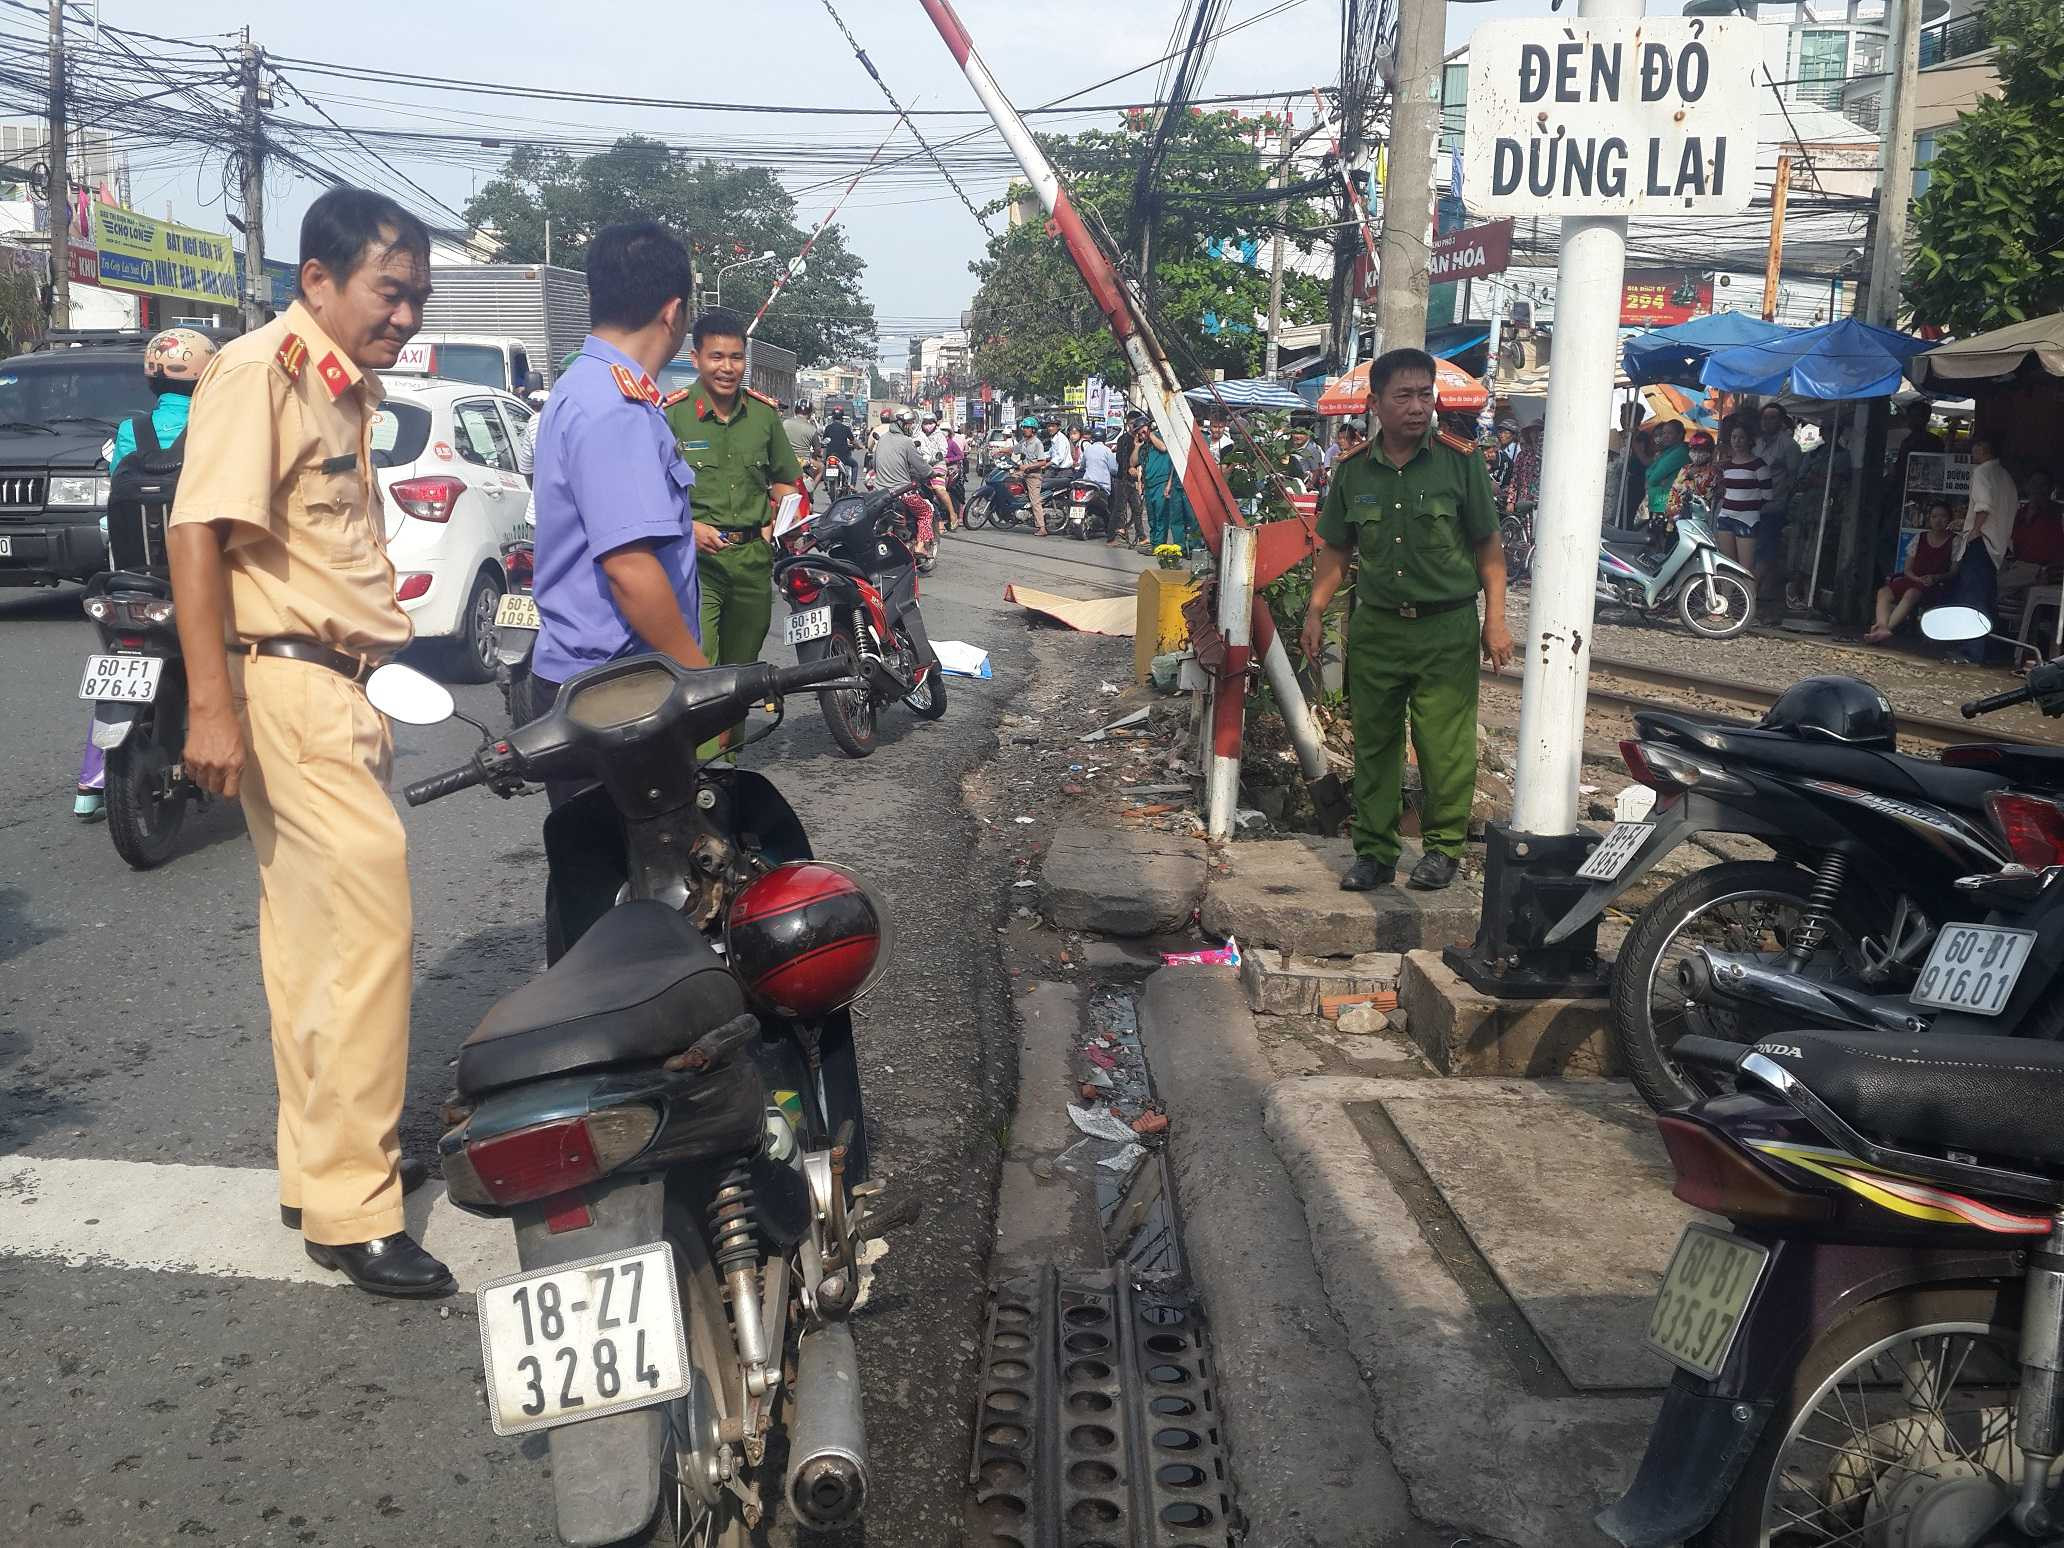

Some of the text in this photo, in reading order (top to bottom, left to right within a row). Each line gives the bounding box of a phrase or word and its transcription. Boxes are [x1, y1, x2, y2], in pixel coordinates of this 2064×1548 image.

[1518, 18, 1709, 103] ĐÈN ĐỎ
[1492, 121, 1727, 208] DỪNG LẠI
[79, 256, 96, 279] KHU
[1429, 249, 1449, 275] ĂN
[1452, 240, 1485, 271] HÓA
[1626, 293, 1665, 309] 294
[398, 349, 423, 363] AXI
[506, 597, 535, 612] 60-B
[501, 611, 539, 626] 109.6
[791, 611, 823, 629] 60-B1
[788, 622, 828, 643] 150.33
[97, 659, 149, 678] 60-F1
[85, 678, 152, 698] 876.43
[1585, 850, 1625, 875] 1956
[1943, 930, 2017, 969] 60-B1
[1919, 966, 2010, 1007] 916.01
[1679, 1236, 1749, 1304] 60-B1
[513, 1260, 644, 1346] 18-Z7
[517, 1328, 660, 1416] 3284
